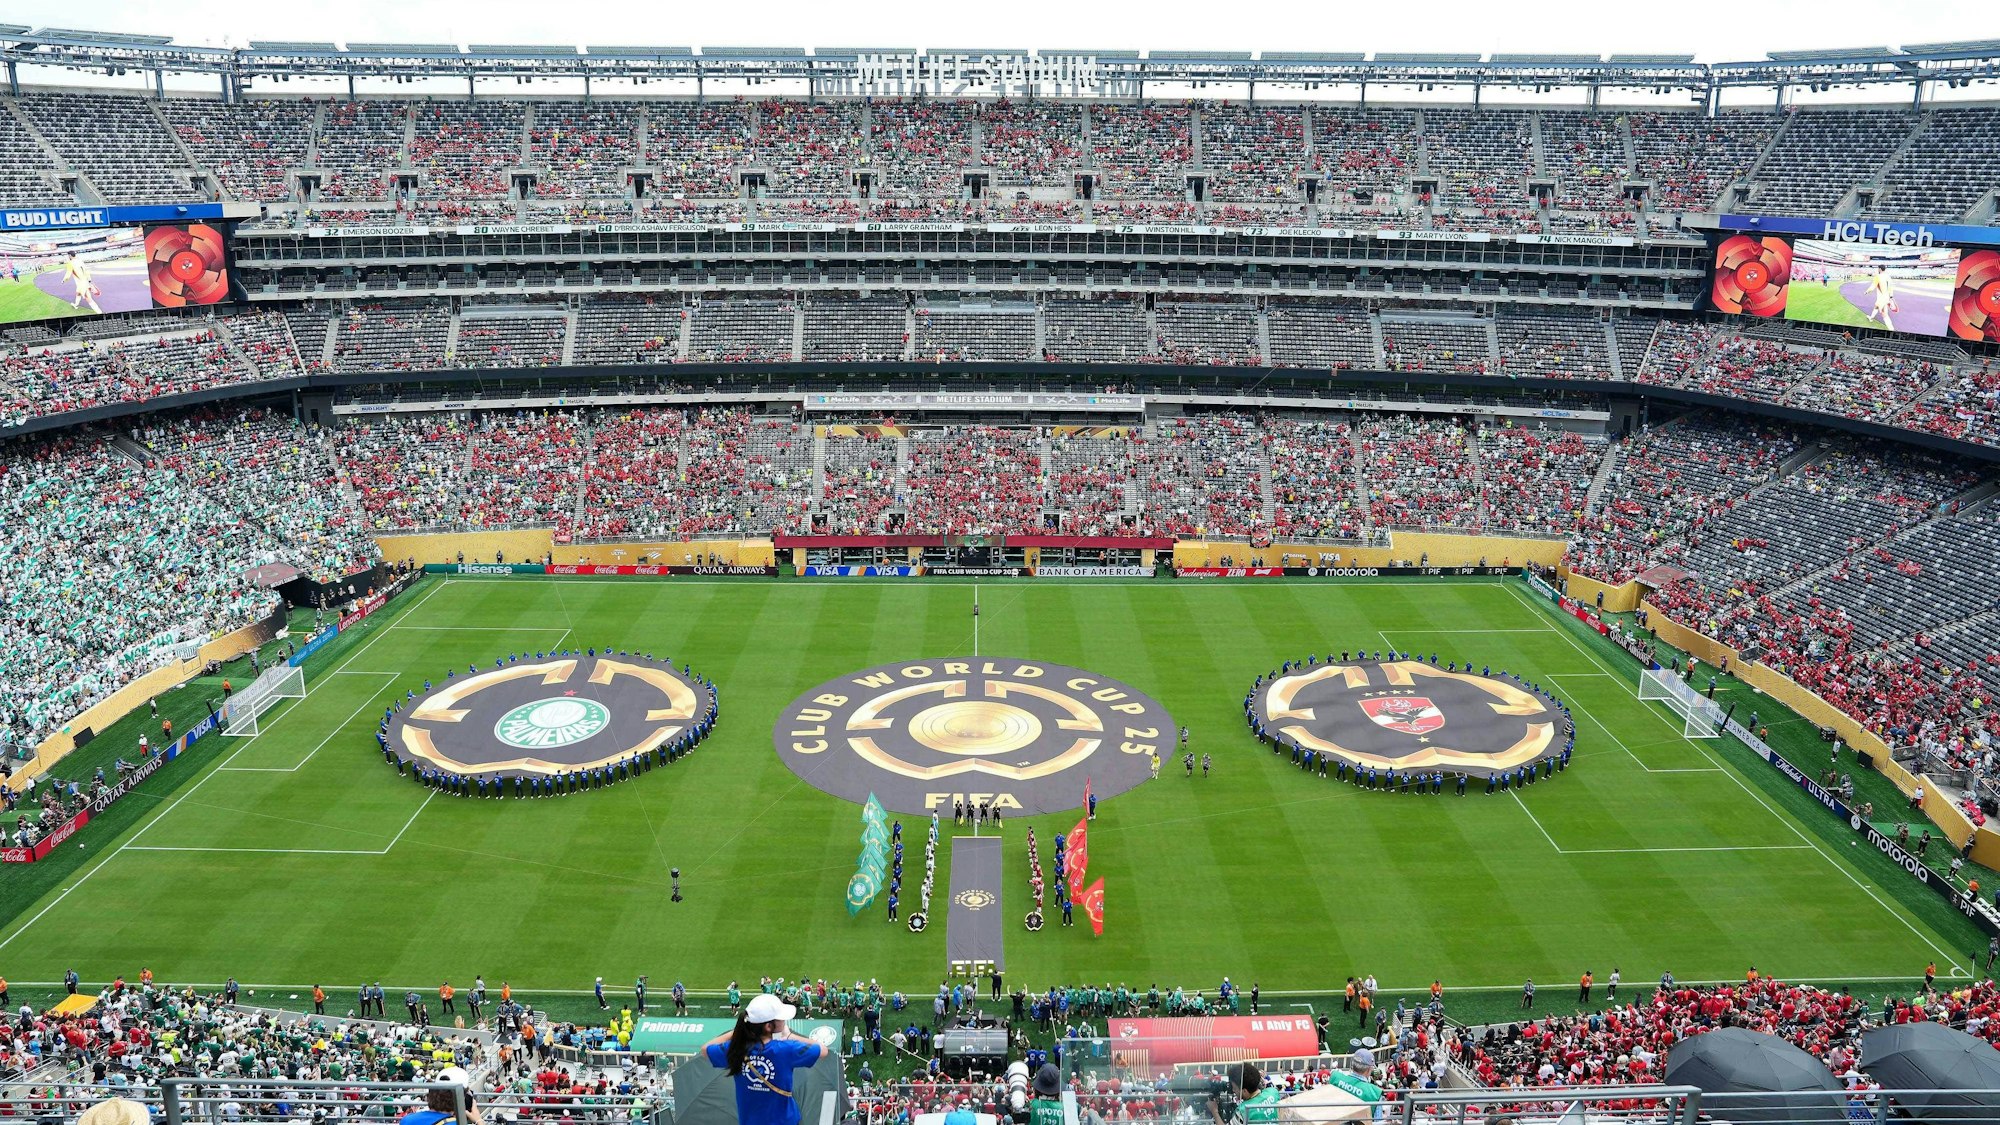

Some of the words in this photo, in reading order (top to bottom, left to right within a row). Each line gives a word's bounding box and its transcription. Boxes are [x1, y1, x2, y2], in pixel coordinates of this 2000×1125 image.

[857, 54, 968, 83] METLIFE
[980, 55, 1096, 85] STADIUM
[5, 212, 47, 227] BUD
[49, 210, 103, 225] LIGHT
[324, 228, 339, 236] 32
[382, 227, 414, 235] BOOZER
[598, 224, 612, 232] 60
[741, 223, 755, 231] 99
[867, 223, 881, 231] 60
[1121, 225, 1133, 233] 75
[1823, 221, 1933, 247] HCLTech
[1399, 231, 1412, 239] 93
[1537, 235, 1551, 243] 74
[1573, 237, 1613, 245] MANGOLD
[1318, 552, 1341, 561] VISA
[457, 563, 513, 574] Hisense
[693, 566, 725, 575] QATAR
[727, 566, 766, 574] AIRWAYS
[815, 566, 839, 576] VISA
[875, 566, 899, 576] VISA
[1175, 568, 1220, 577] Budweiser
[1225, 568, 1246, 577] ZERO
[1325, 567, 1378, 577] motorola
[1527, 574, 1553, 600] Hisense
[364, 597, 386, 616] Lenovo
[339, 612, 361, 632] Lenovo
[1609, 630, 1627, 649] QATAR
[1628, 643, 1650, 666] AIRWAYS
[791, 692, 849, 755] CLUB
[851, 662, 1045, 689] WORLD
[1066, 677, 1146, 718] CUP
[1119, 726, 1160, 758] 25
[192, 718, 212, 740] VISA
[501, 718, 602, 746] PALMEIRAS
[1706, 704, 1724, 722] BANK
[1732, 726, 1760, 750] AMERICA
[94, 785, 126, 813] QATAR
[127, 756, 163, 789] AIRWAYS
[1775, 759, 1801, 783] Michelob
[1807, 782, 1835, 811] ULTRA
[924, 793, 1025, 809] FIFA
[1867, 829, 1928, 883] motorola
[1960, 902, 1977, 918] PIF
[951, 959, 996, 977] FIFA
[641, 1021, 704, 1033] Palmeiras
[1251, 1020, 1264, 1031] Al
[1266, 1020, 1292, 1031] Ahly
[1295, 1019, 1310, 1030] FC
[765, 1059, 775, 1071] CUP
[1338, 1080, 1363, 1096] PHOTO
[1037, 1107, 1064, 1117] PHOTO
